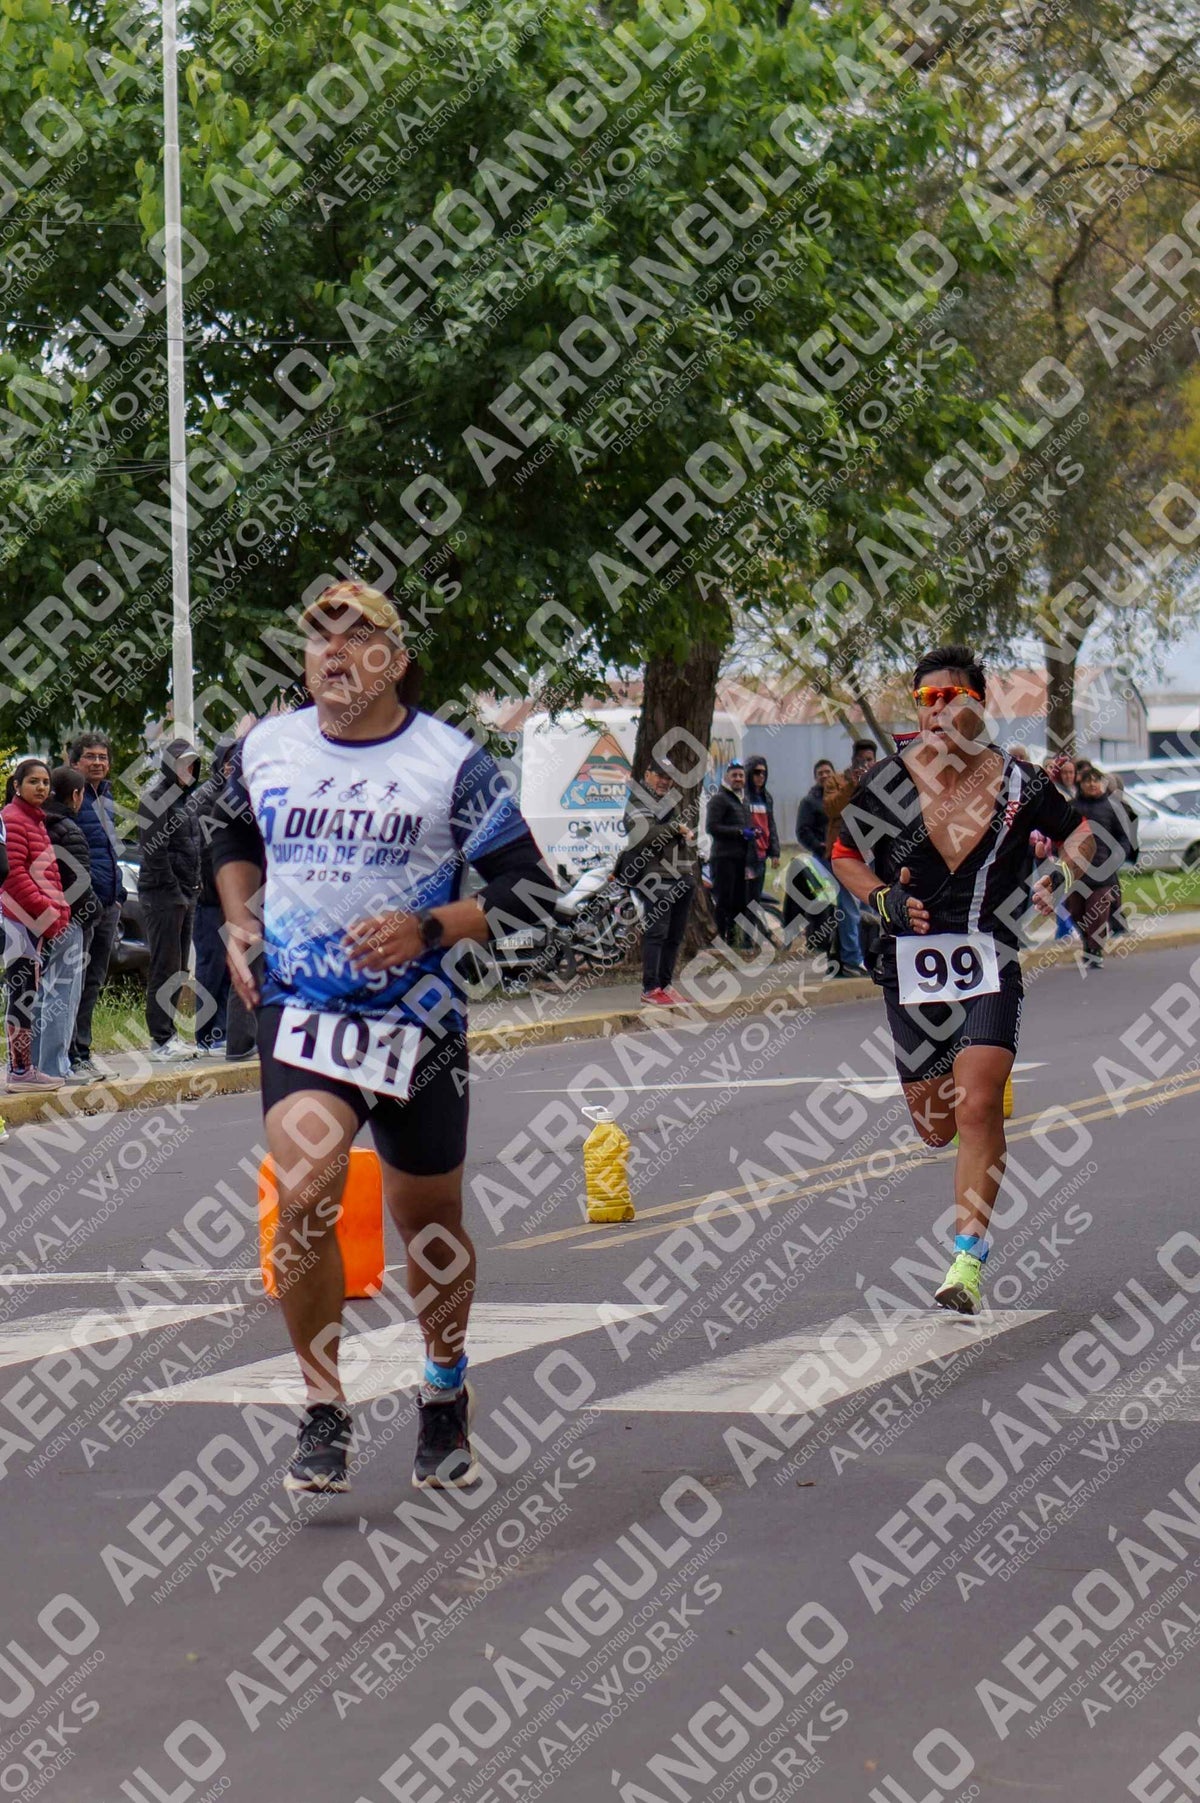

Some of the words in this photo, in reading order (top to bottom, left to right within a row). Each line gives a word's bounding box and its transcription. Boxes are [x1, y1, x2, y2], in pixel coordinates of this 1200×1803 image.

[586, 784, 627, 796] ADN
[284, 807, 423, 846] DUATLÓN
[332, 845, 358, 866] DE
[305, 869, 352, 883] 2026
[914, 945, 984, 993] 99
[290, 1013, 407, 1085] 101
